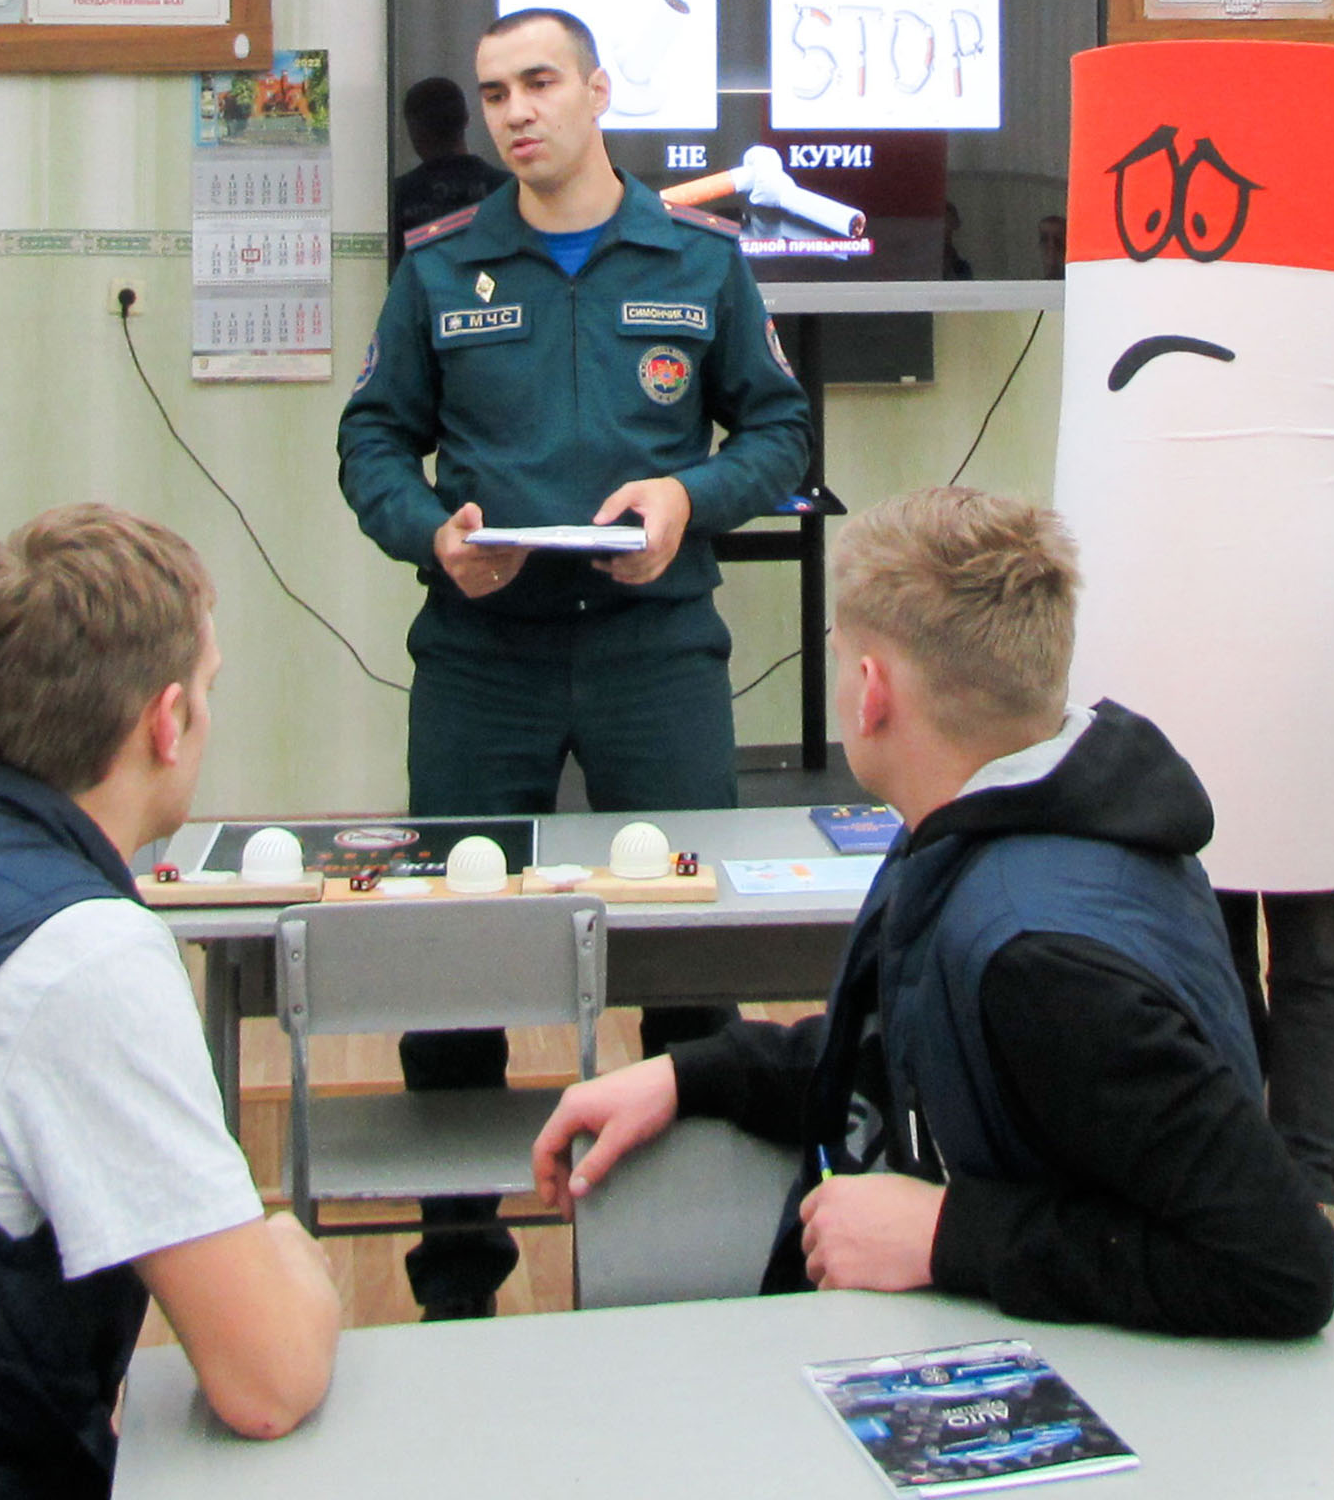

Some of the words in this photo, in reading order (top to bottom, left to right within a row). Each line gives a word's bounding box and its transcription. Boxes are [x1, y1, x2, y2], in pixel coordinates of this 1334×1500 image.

[792, 3, 984, 101] STOP
[666, 145, 708, 168] НЕ
[788, 145, 873, 168] КУРИ!
[740, 238, 787, 253] ЕДНОЙ
[788, 238, 871, 252] ПРИВЫЧКОЙ
[469, 310, 513, 328] МЧС
